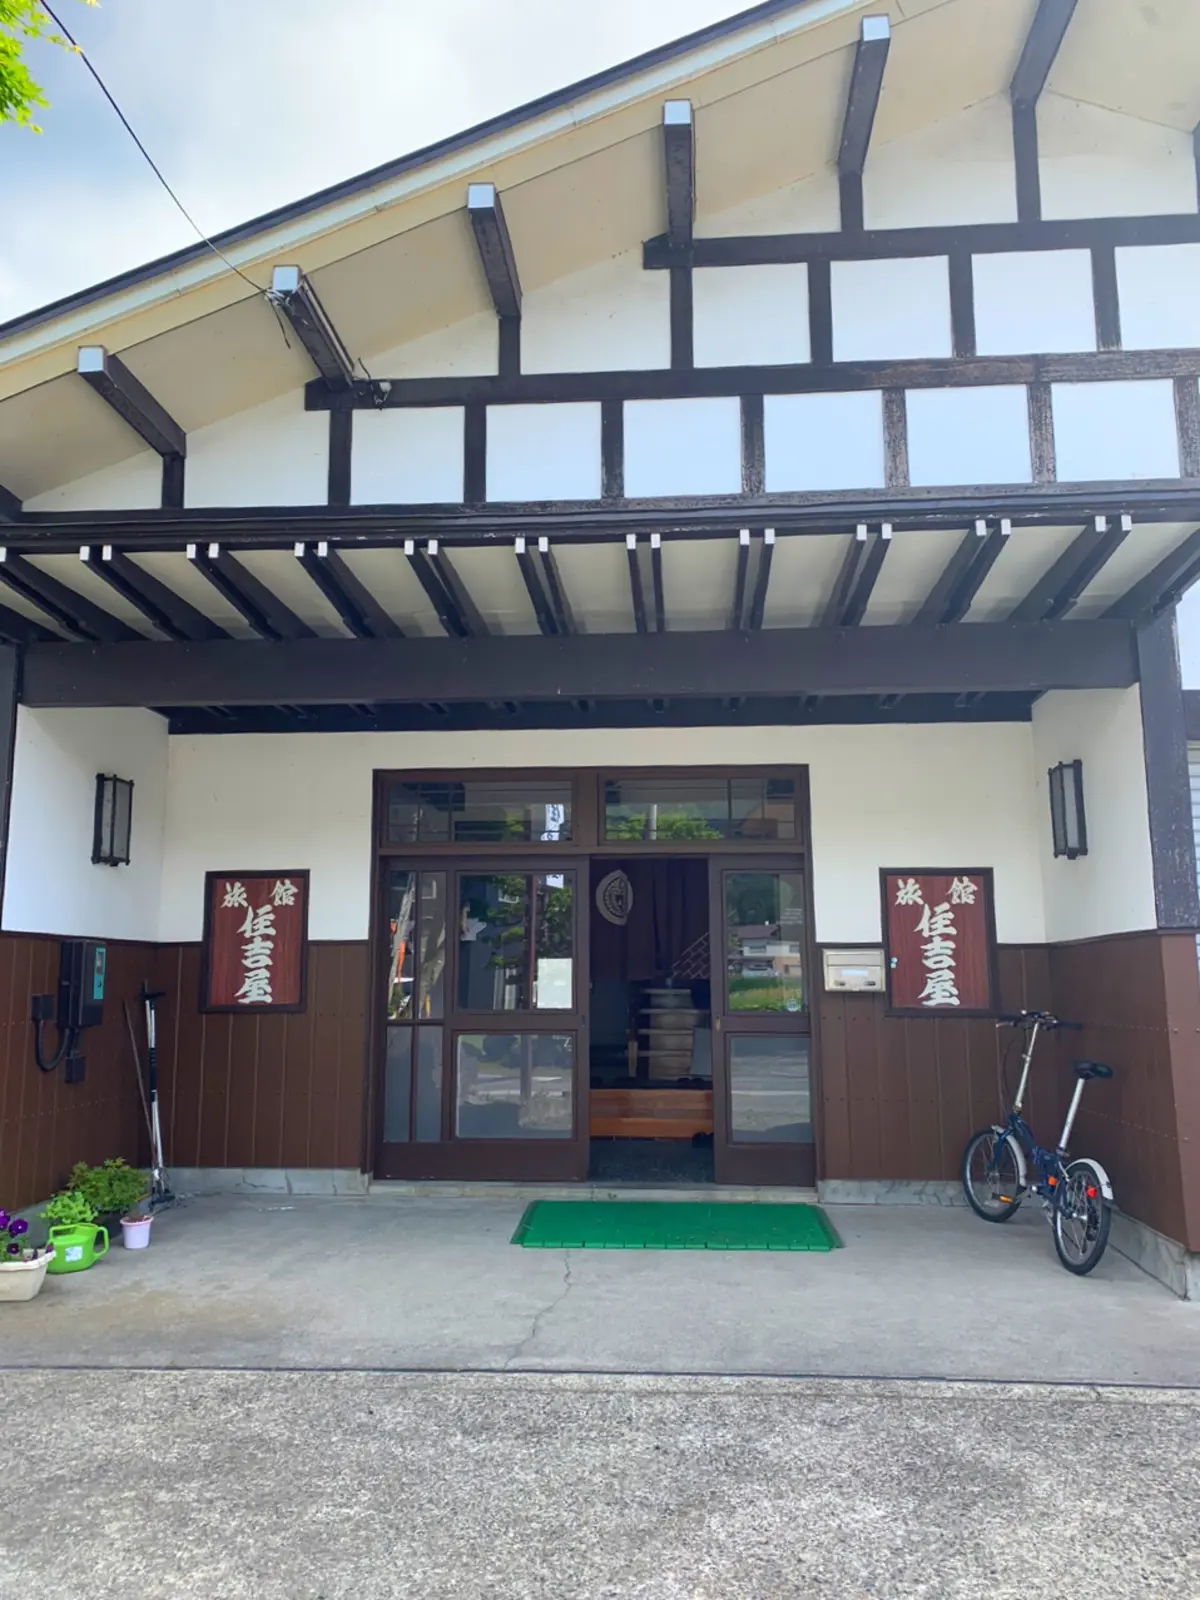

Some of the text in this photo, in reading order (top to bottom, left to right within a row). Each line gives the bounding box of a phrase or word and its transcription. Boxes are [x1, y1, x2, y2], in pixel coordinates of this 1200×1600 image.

[220, 879, 298, 908] 旅館
[895, 876, 978, 906] 旅館
[234, 904, 277, 1004] 住吉屋
[914, 902, 960, 1006] 住吉屋
